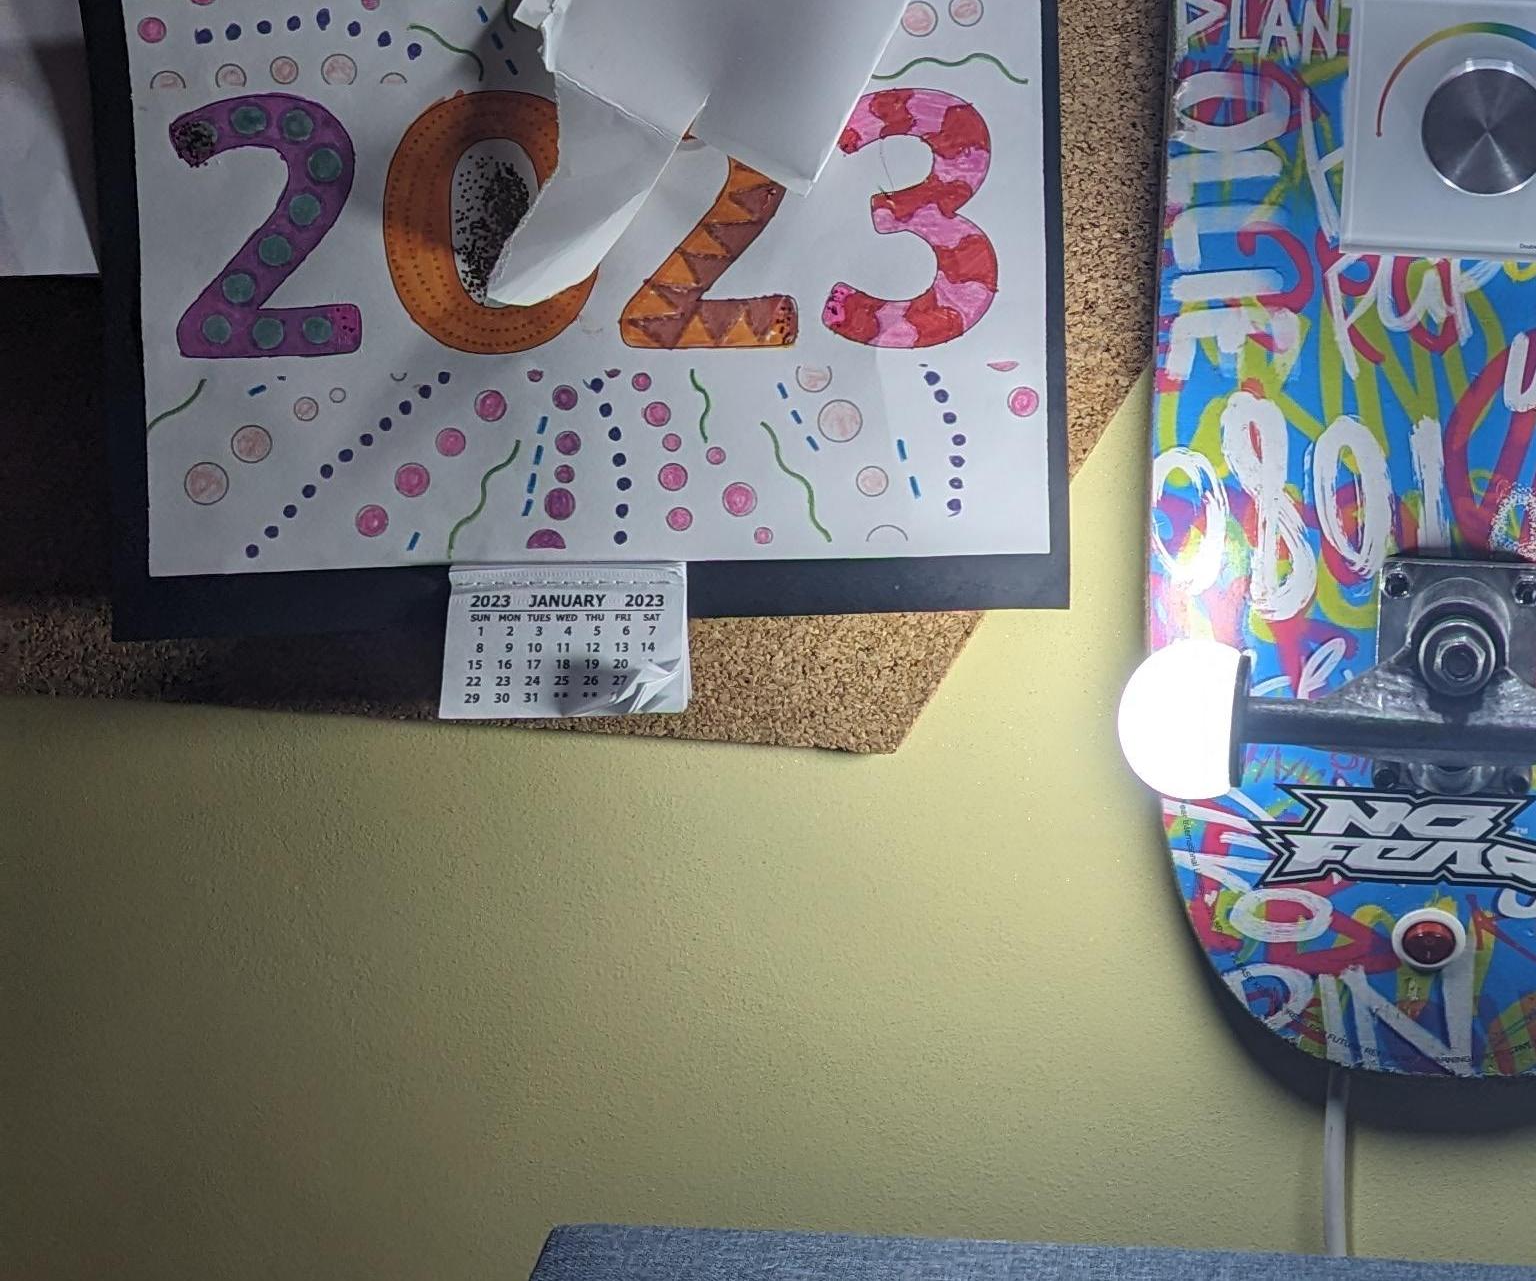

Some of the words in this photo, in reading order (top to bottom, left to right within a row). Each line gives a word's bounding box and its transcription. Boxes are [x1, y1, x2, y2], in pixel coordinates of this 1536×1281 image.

[470, 595, 511, 607] 2023
[529, 594, 606, 608] JANUARY
[625, 594, 664, 607] 2023
[471, 614, 490, 622] SUN
[499, 614, 521, 622] MON
[527, 614, 551, 622] TUES
[556, 614, 578, 622] WED
[585, 614, 605, 622] THU
[615, 614, 632, 622] FRI
[643, 614, 661, 622] SAT
[478, 626, 484, 636] 1
[506, 626, 514, 636] 2
[536, 626, 543, 636] 3
[564, 626, 572, 636] 4
[594, 626, 601, 636] 5
[622, 626, 630, 636] 6
[649, 626, 656, 636] 7
[476, 643, 484, 653] 8
[505, 643, 513, 653] 9
[528, 643, 542, 653] 10
[557, 643, 570, 653] 11
[586, 643, 600, 653] 12
[615, 643, 629, 653] 13
[641, 643, 655, 653] 14
[468, 659, 483, 670] 15
[497, 659, 512, 670] 16
[527, 659, 541, 670] 17
[556, 659, 570, 670] 18
[585, 659, 600, 670] 19
[614, 659, 628, 670] 20
[466, 676, 482, 687] 22
[496, 676, 511, 687] 23
[525, 676, 540, 687] 24
[554, 676, 569, 687] 25
[583, 676, 598, 687] 26
[612, 676, 628, 687] 27
[464, 693, 480, 703] 29
[494, 693, 510, 703] 30
[523, 693, 538, 703] 31
[1310, 795, 1508, 839] NO
